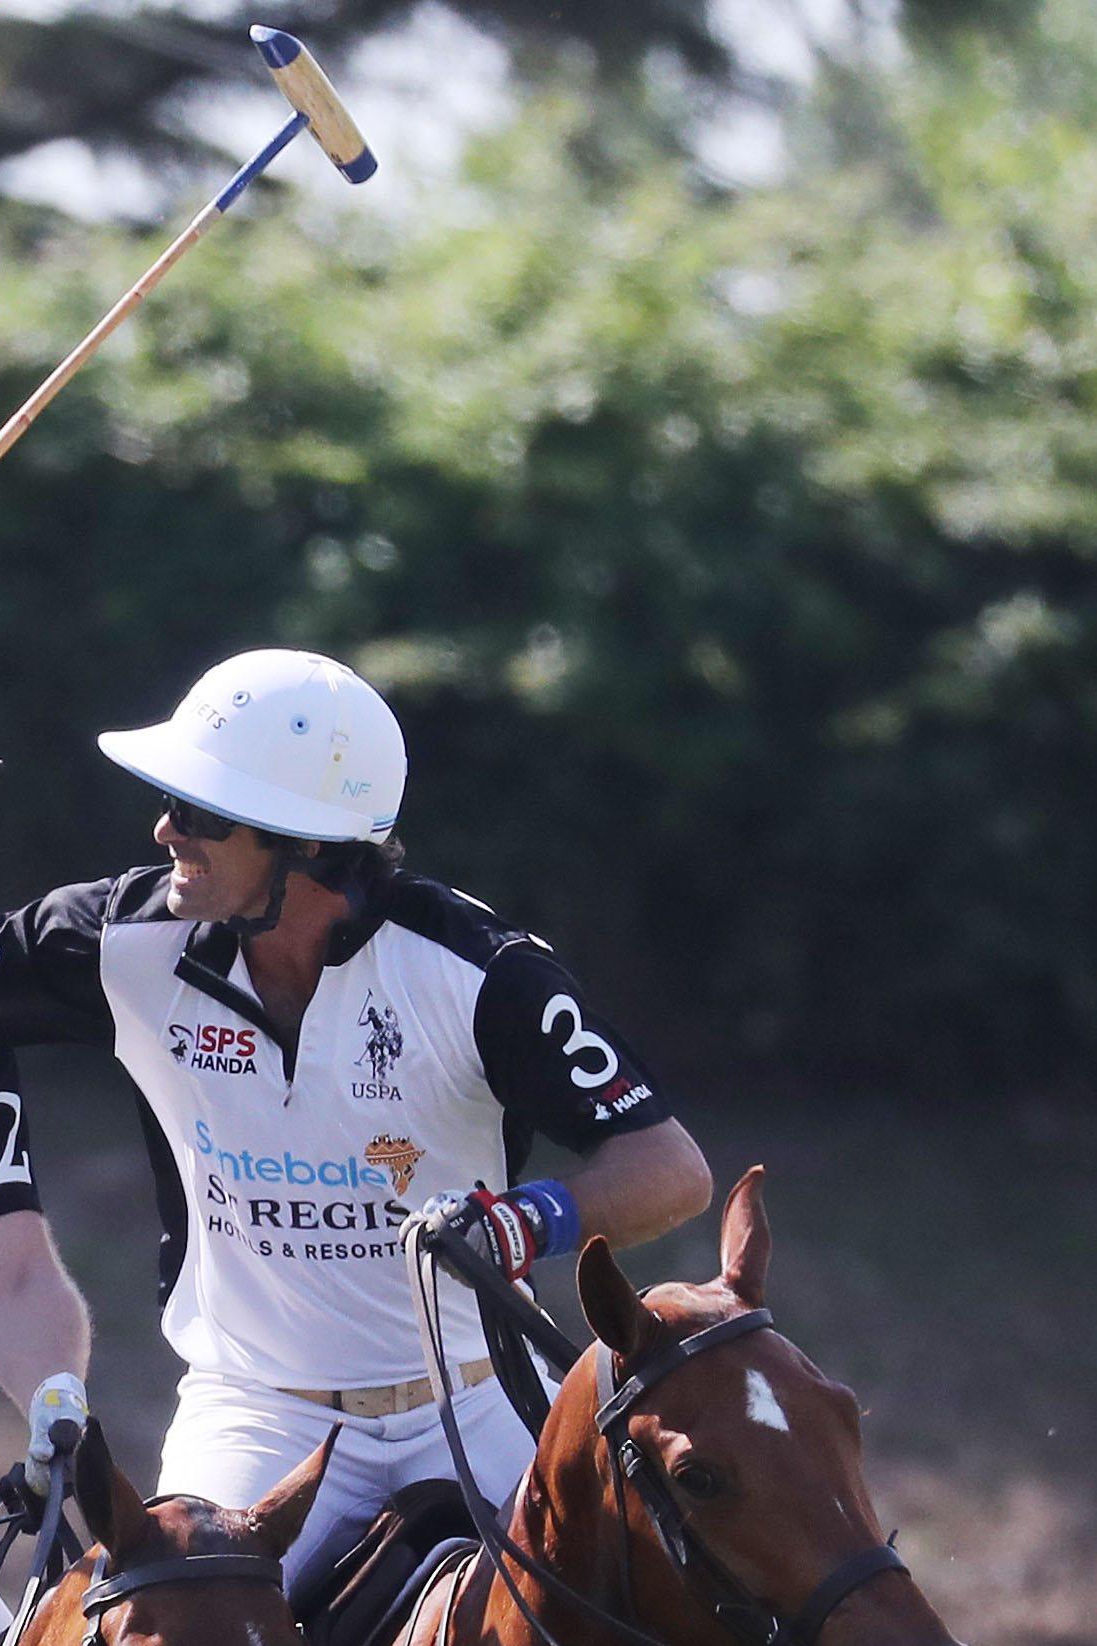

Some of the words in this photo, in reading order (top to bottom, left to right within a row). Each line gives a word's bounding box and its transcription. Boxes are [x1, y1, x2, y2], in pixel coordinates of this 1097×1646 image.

[341, 779, 372, 798] NF
[196, 1023, 256, 1057] ISPS
[541, 993, 619, 1089] 3
[191, 1052, 257, 1075] HANDA
[351, 1082, 403, 1101] USPA
[282, 1242, 297, 1259] &
